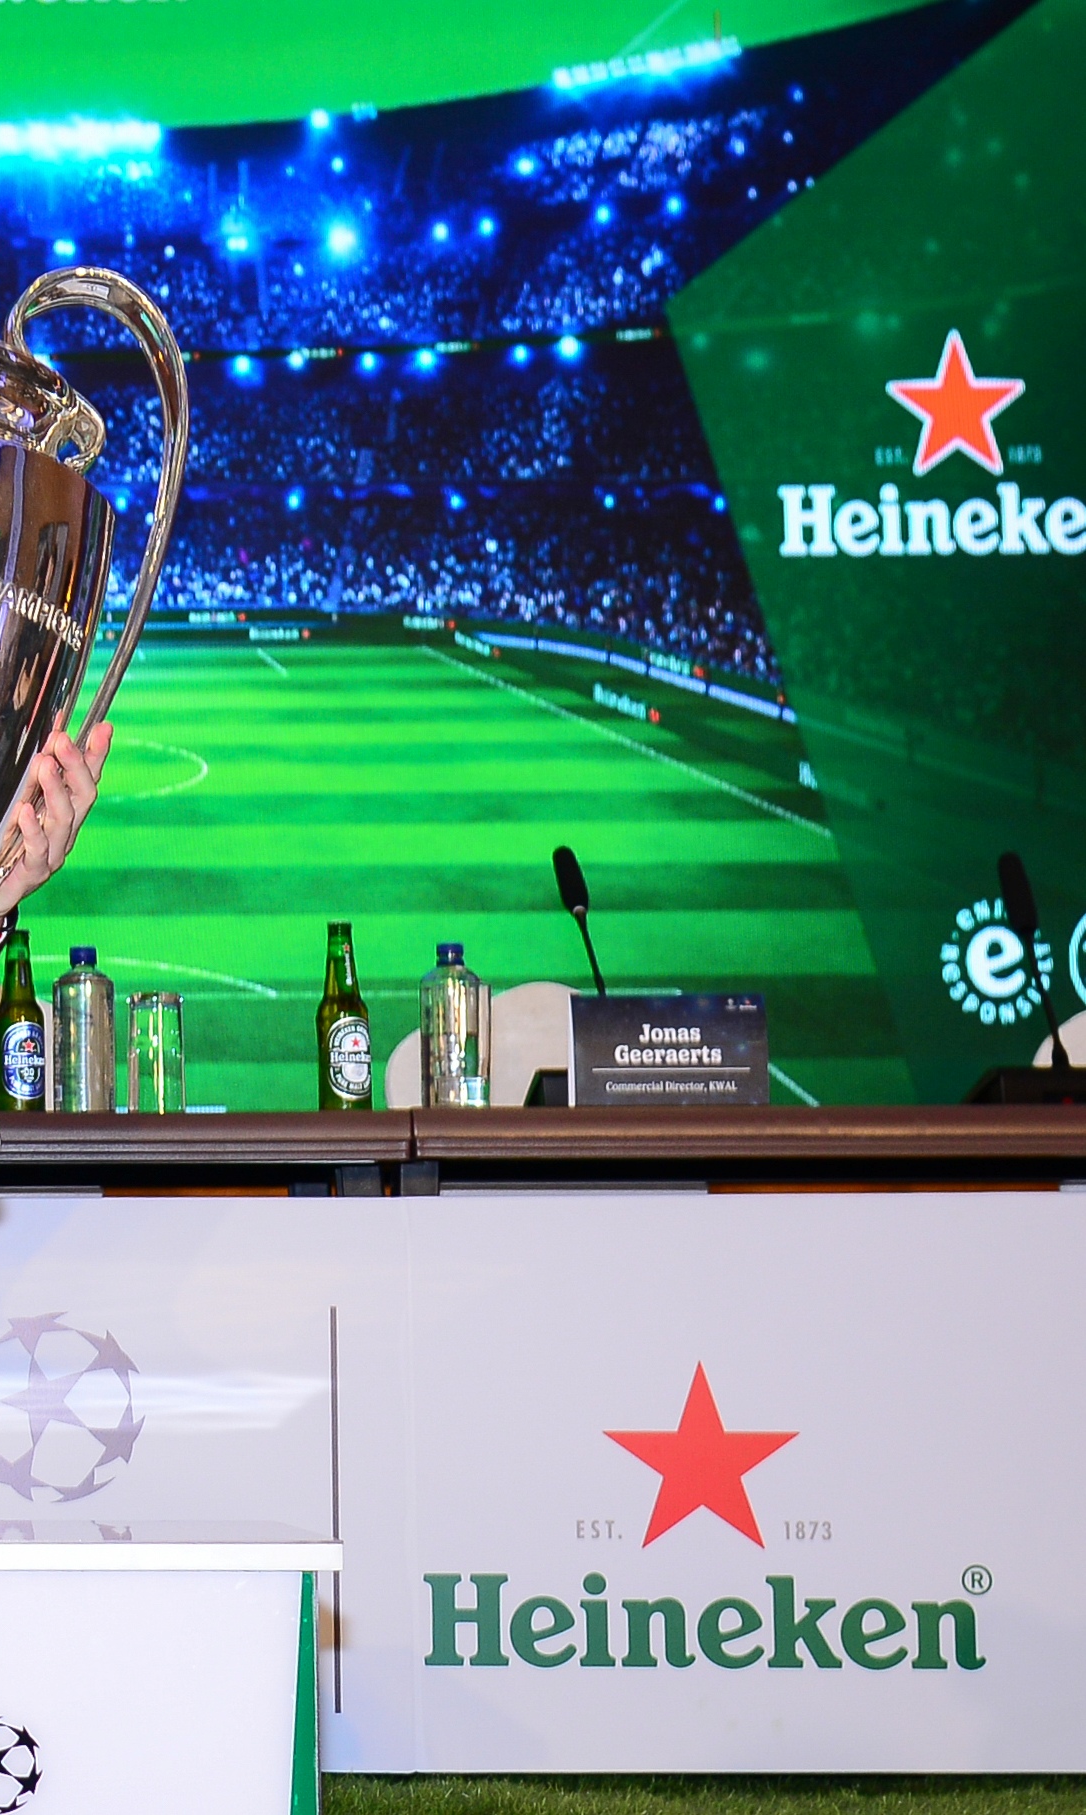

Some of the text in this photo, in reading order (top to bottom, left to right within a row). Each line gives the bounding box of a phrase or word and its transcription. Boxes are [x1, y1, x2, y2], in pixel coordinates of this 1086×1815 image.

[639, 1023, 701, 1043] Jonas
[614, 1045, 722, 1065] Geeraerts
[606, 1081, 738, 1092] Commercial Director, KWAL
[575, 1520, 832, 1541] EST. 1873
[423, 1571, 987, 1671] Heineken
